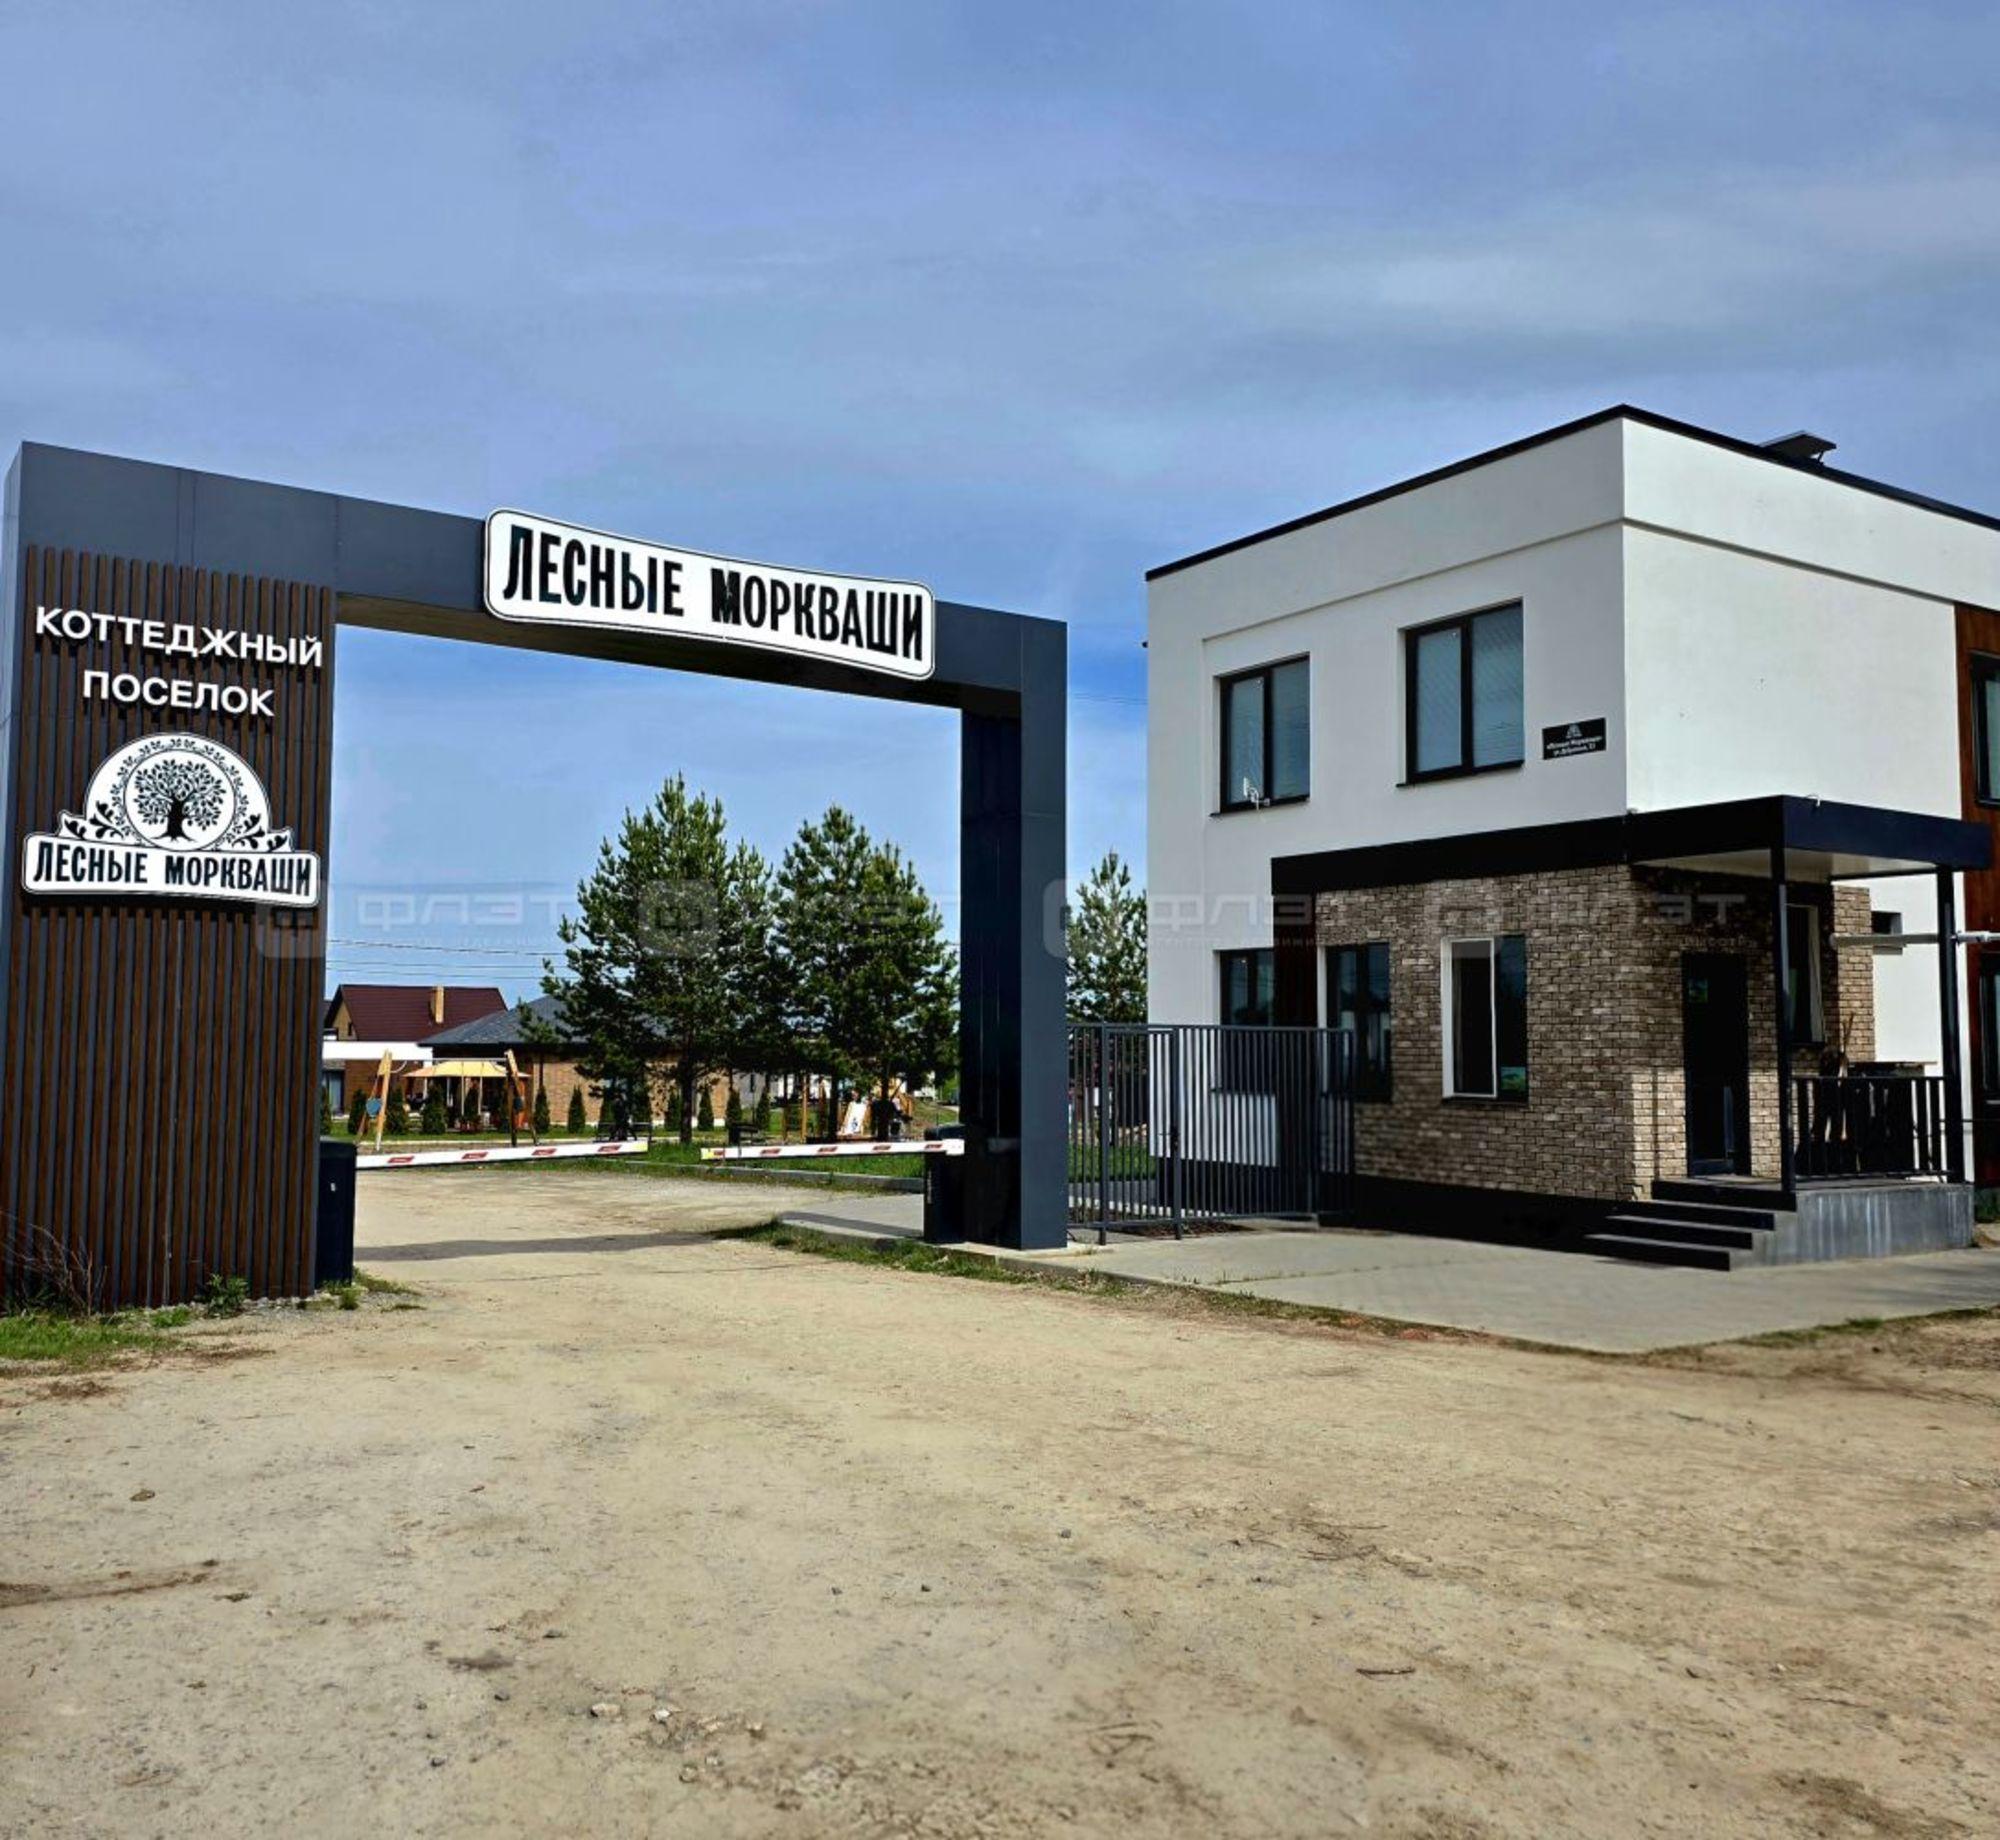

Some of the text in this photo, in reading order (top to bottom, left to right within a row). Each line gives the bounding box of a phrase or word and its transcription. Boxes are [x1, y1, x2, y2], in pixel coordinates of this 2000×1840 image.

[503, 524, 923, 661] ЛЕСНЫЕ МОРКВАШИ
[35, 606, 323, 667] КОТТЕДЖНЫЙ
[83, 670, 275, 717] ПОСЕЛОК
[33, 841, 312, 897] ЛЕСНЫЕ МОРКВАШИ
